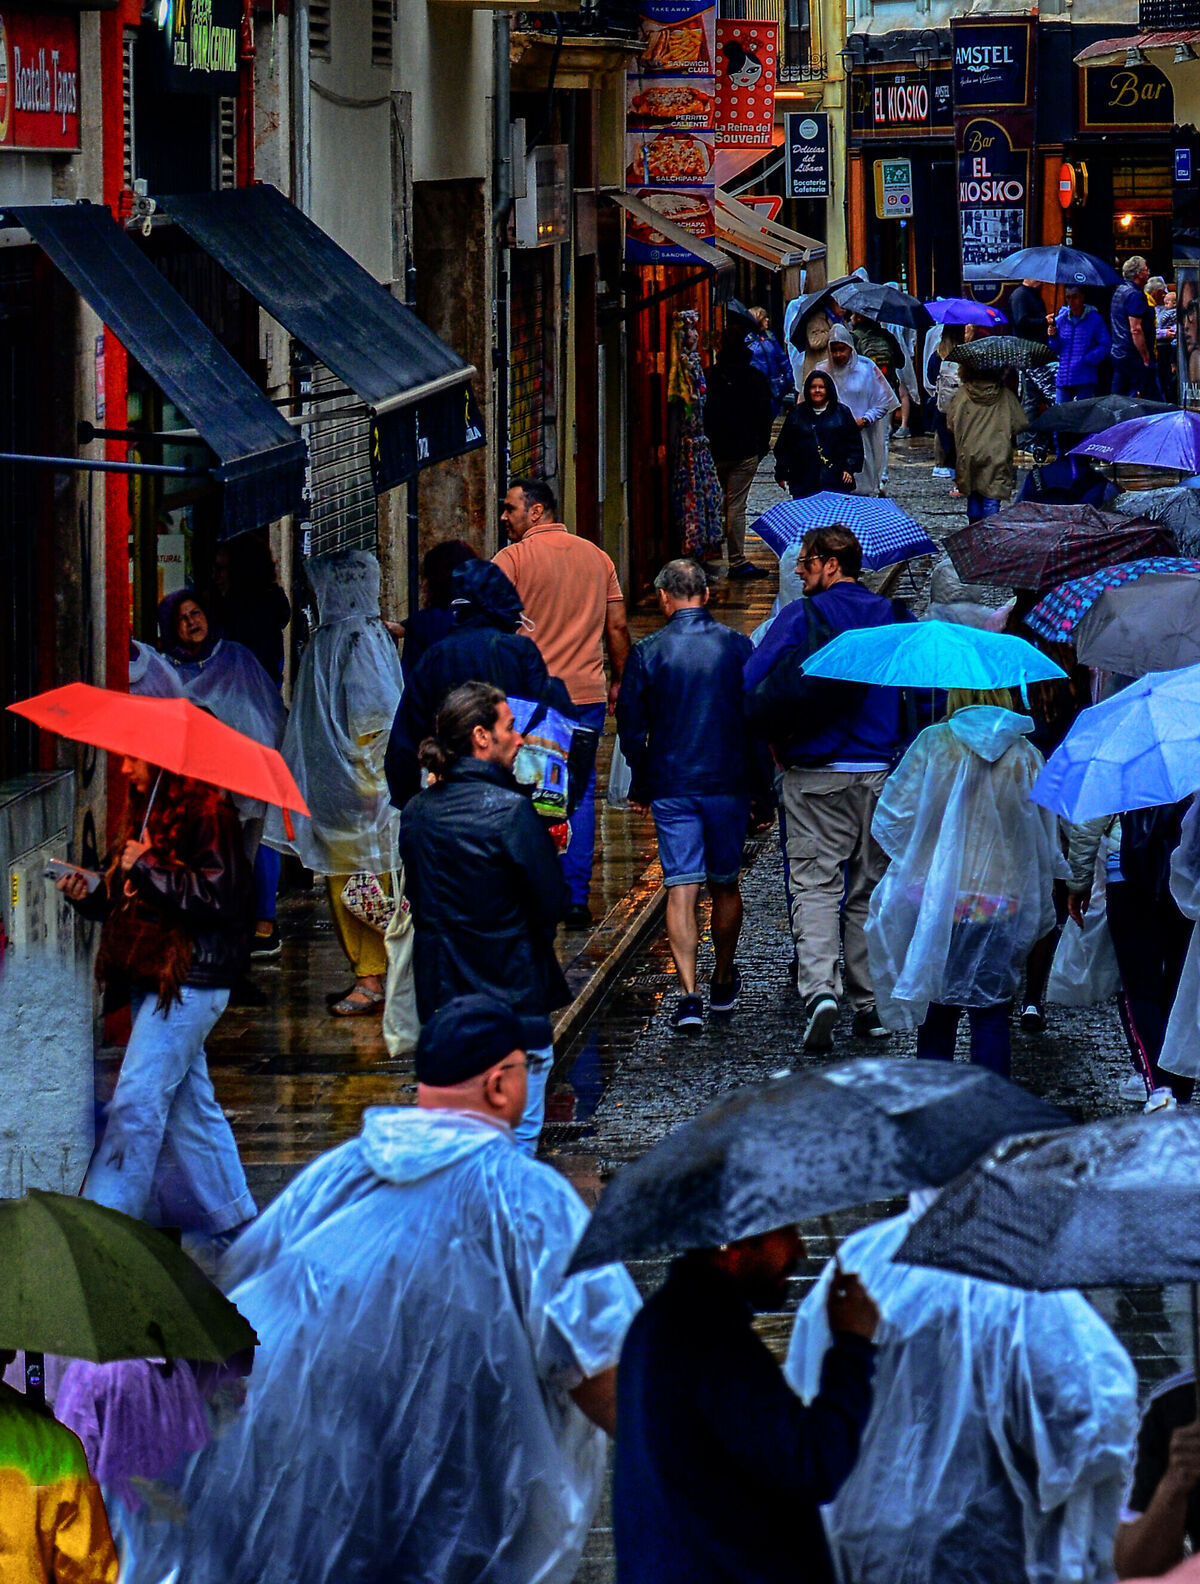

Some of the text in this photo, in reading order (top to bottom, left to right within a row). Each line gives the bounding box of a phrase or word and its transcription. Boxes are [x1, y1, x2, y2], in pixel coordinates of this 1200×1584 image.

[955, 46, 1014, 64] AMSTEL
[14, 46, 76, 134] Boatella Tapas
[1108, 71, 1167, 108] Bar
[874, 84, 928, 122] EL KIOSKO
[714, 123, 770, 132] La Reina del
[715, 132, 770, 144] Souvenir
[792, 144, 826, 154] Delicias
[969, 130, 995, 152] Bar
[802, 154, 816, 162] del
[972, 157, 992, 178] EL
[960, 180, 1024, 202] KIOSKO
